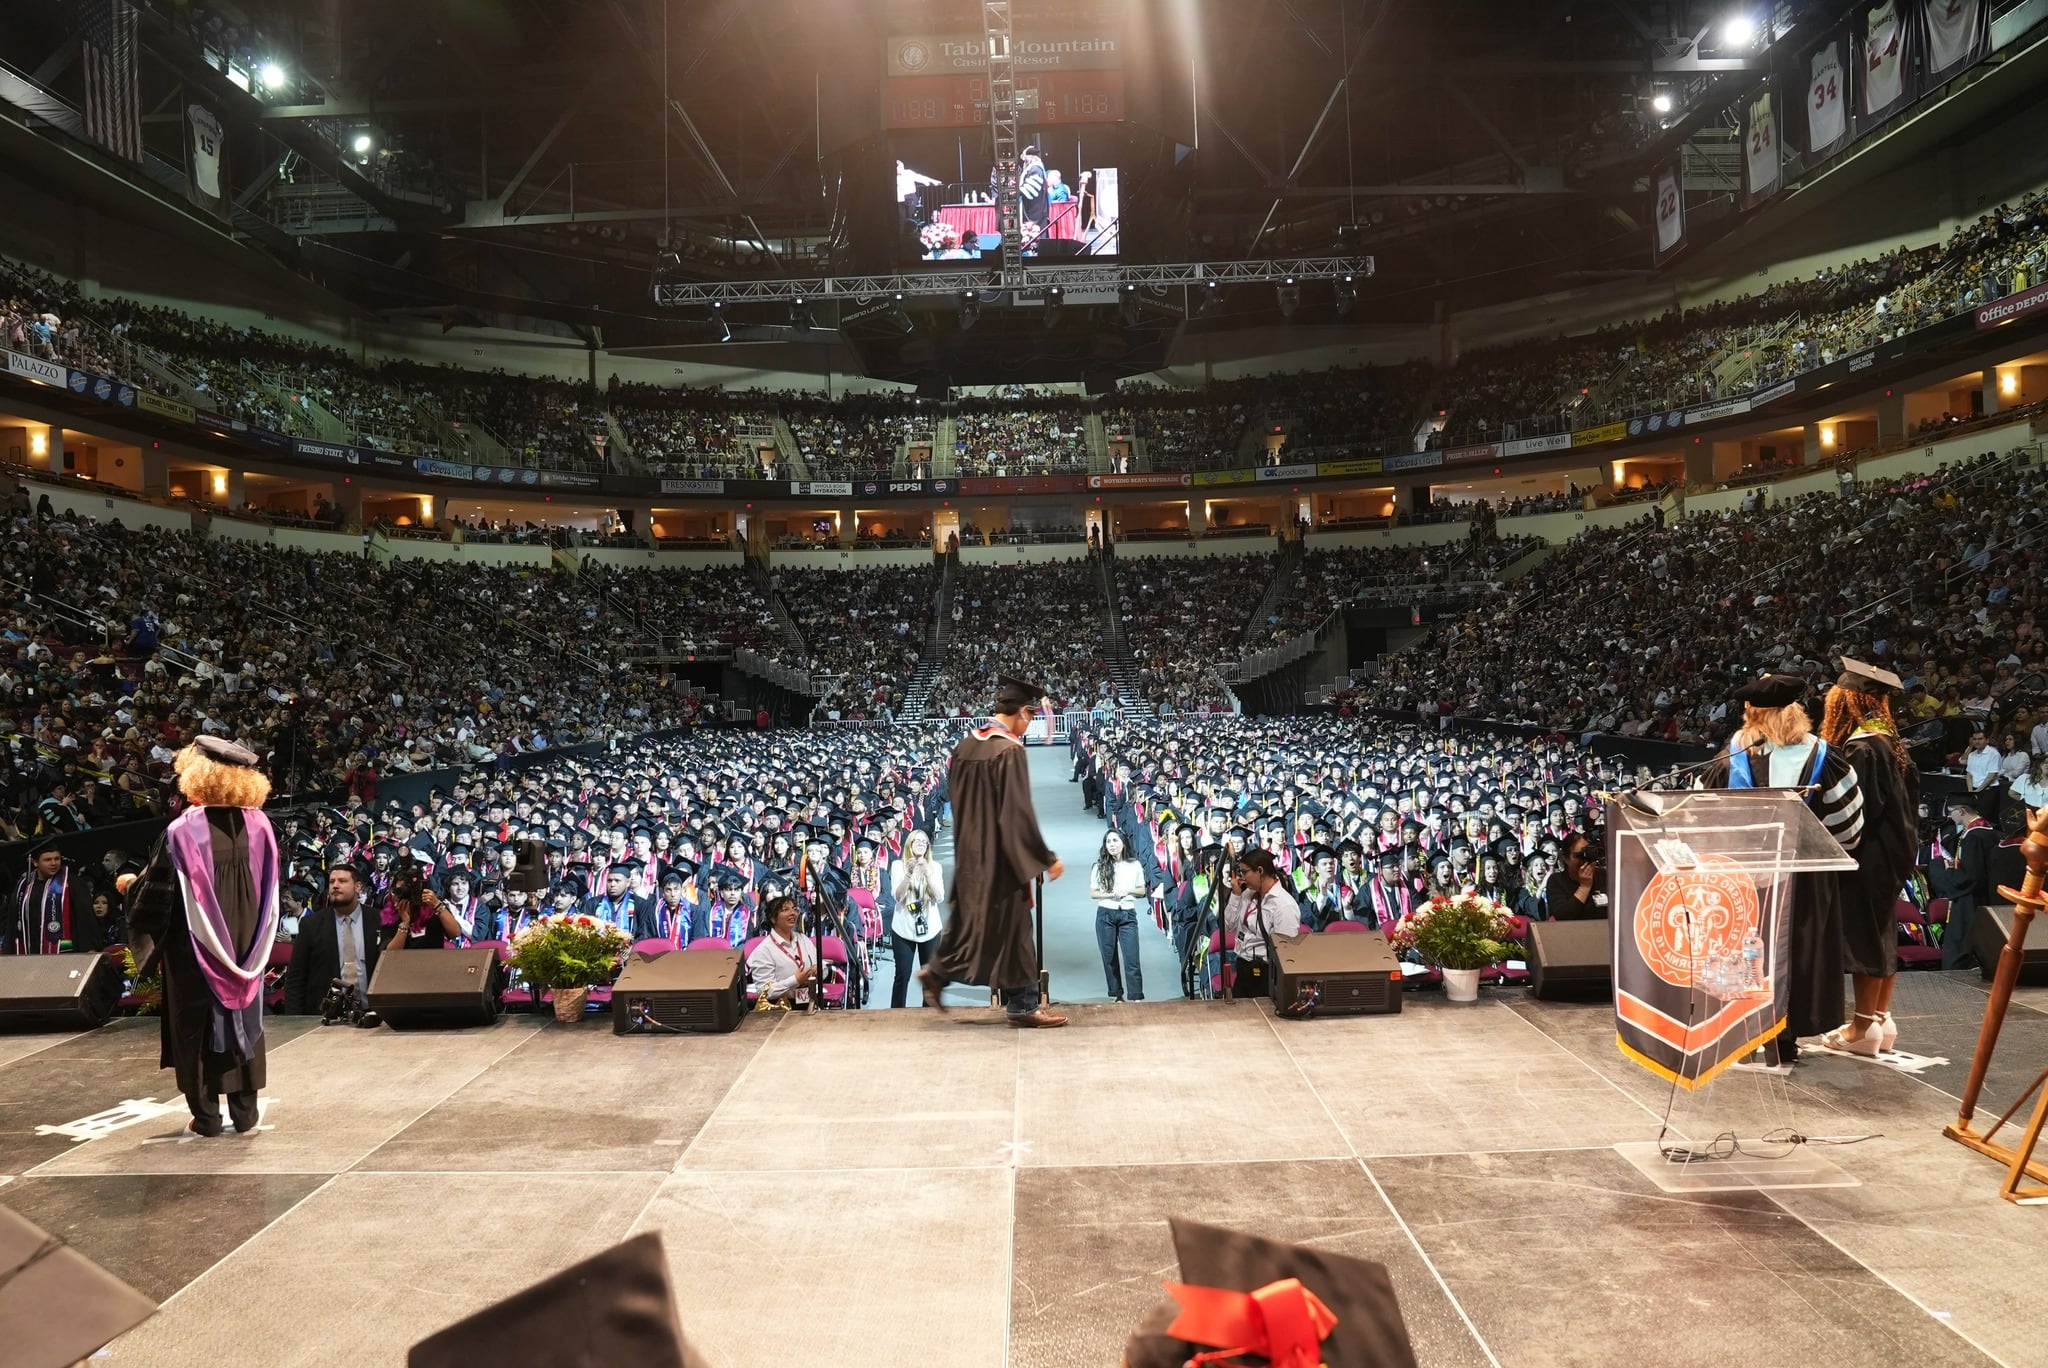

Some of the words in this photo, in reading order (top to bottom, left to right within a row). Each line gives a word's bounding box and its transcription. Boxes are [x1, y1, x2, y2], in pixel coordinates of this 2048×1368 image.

[1013, 54, 1060, 66] Resort
[1814, 75, 1837, 110] 34
[200, 133, 214, 157] 15
[1752, 124, 1770, 155] 24
[1660, 191, 1676, 222] 22
[841, 309, 867, 323] FRESNO
[866, 301, 890, 315] LEXUS
[1979, 304, 2015, 324] Office
[2015, 292, 2048, 312] DEPOT
[1861, 351, 1875, 362] MORE
[11, 354, 59, 379] PALAZZO
[674, 367, 683, 375] 206
[1700, 406, 1735, 418] ticketmaster
[1525, 439, 1544, 449] Live
[1545, 435, 1567, 446] Well
[298, 443, 324, 456] FRESNO
[324, 448, 344, 458] STATE
[1926, 447, 1934, 457] 124
[450, 466, 473, 481] LIGHT
[551, 473, 569, 482] Table
[569, 475, 600, 484] Mountain
[1264, 468, 1278, 478] OK
[1277, 467, 1308, 479] produce
[665, 480, 694, 489] FRESNO
[696, 480, 720, 489] STATE
[889, 482, 922, 492] PEPSI
[1090, 475, 1101, 488] G
